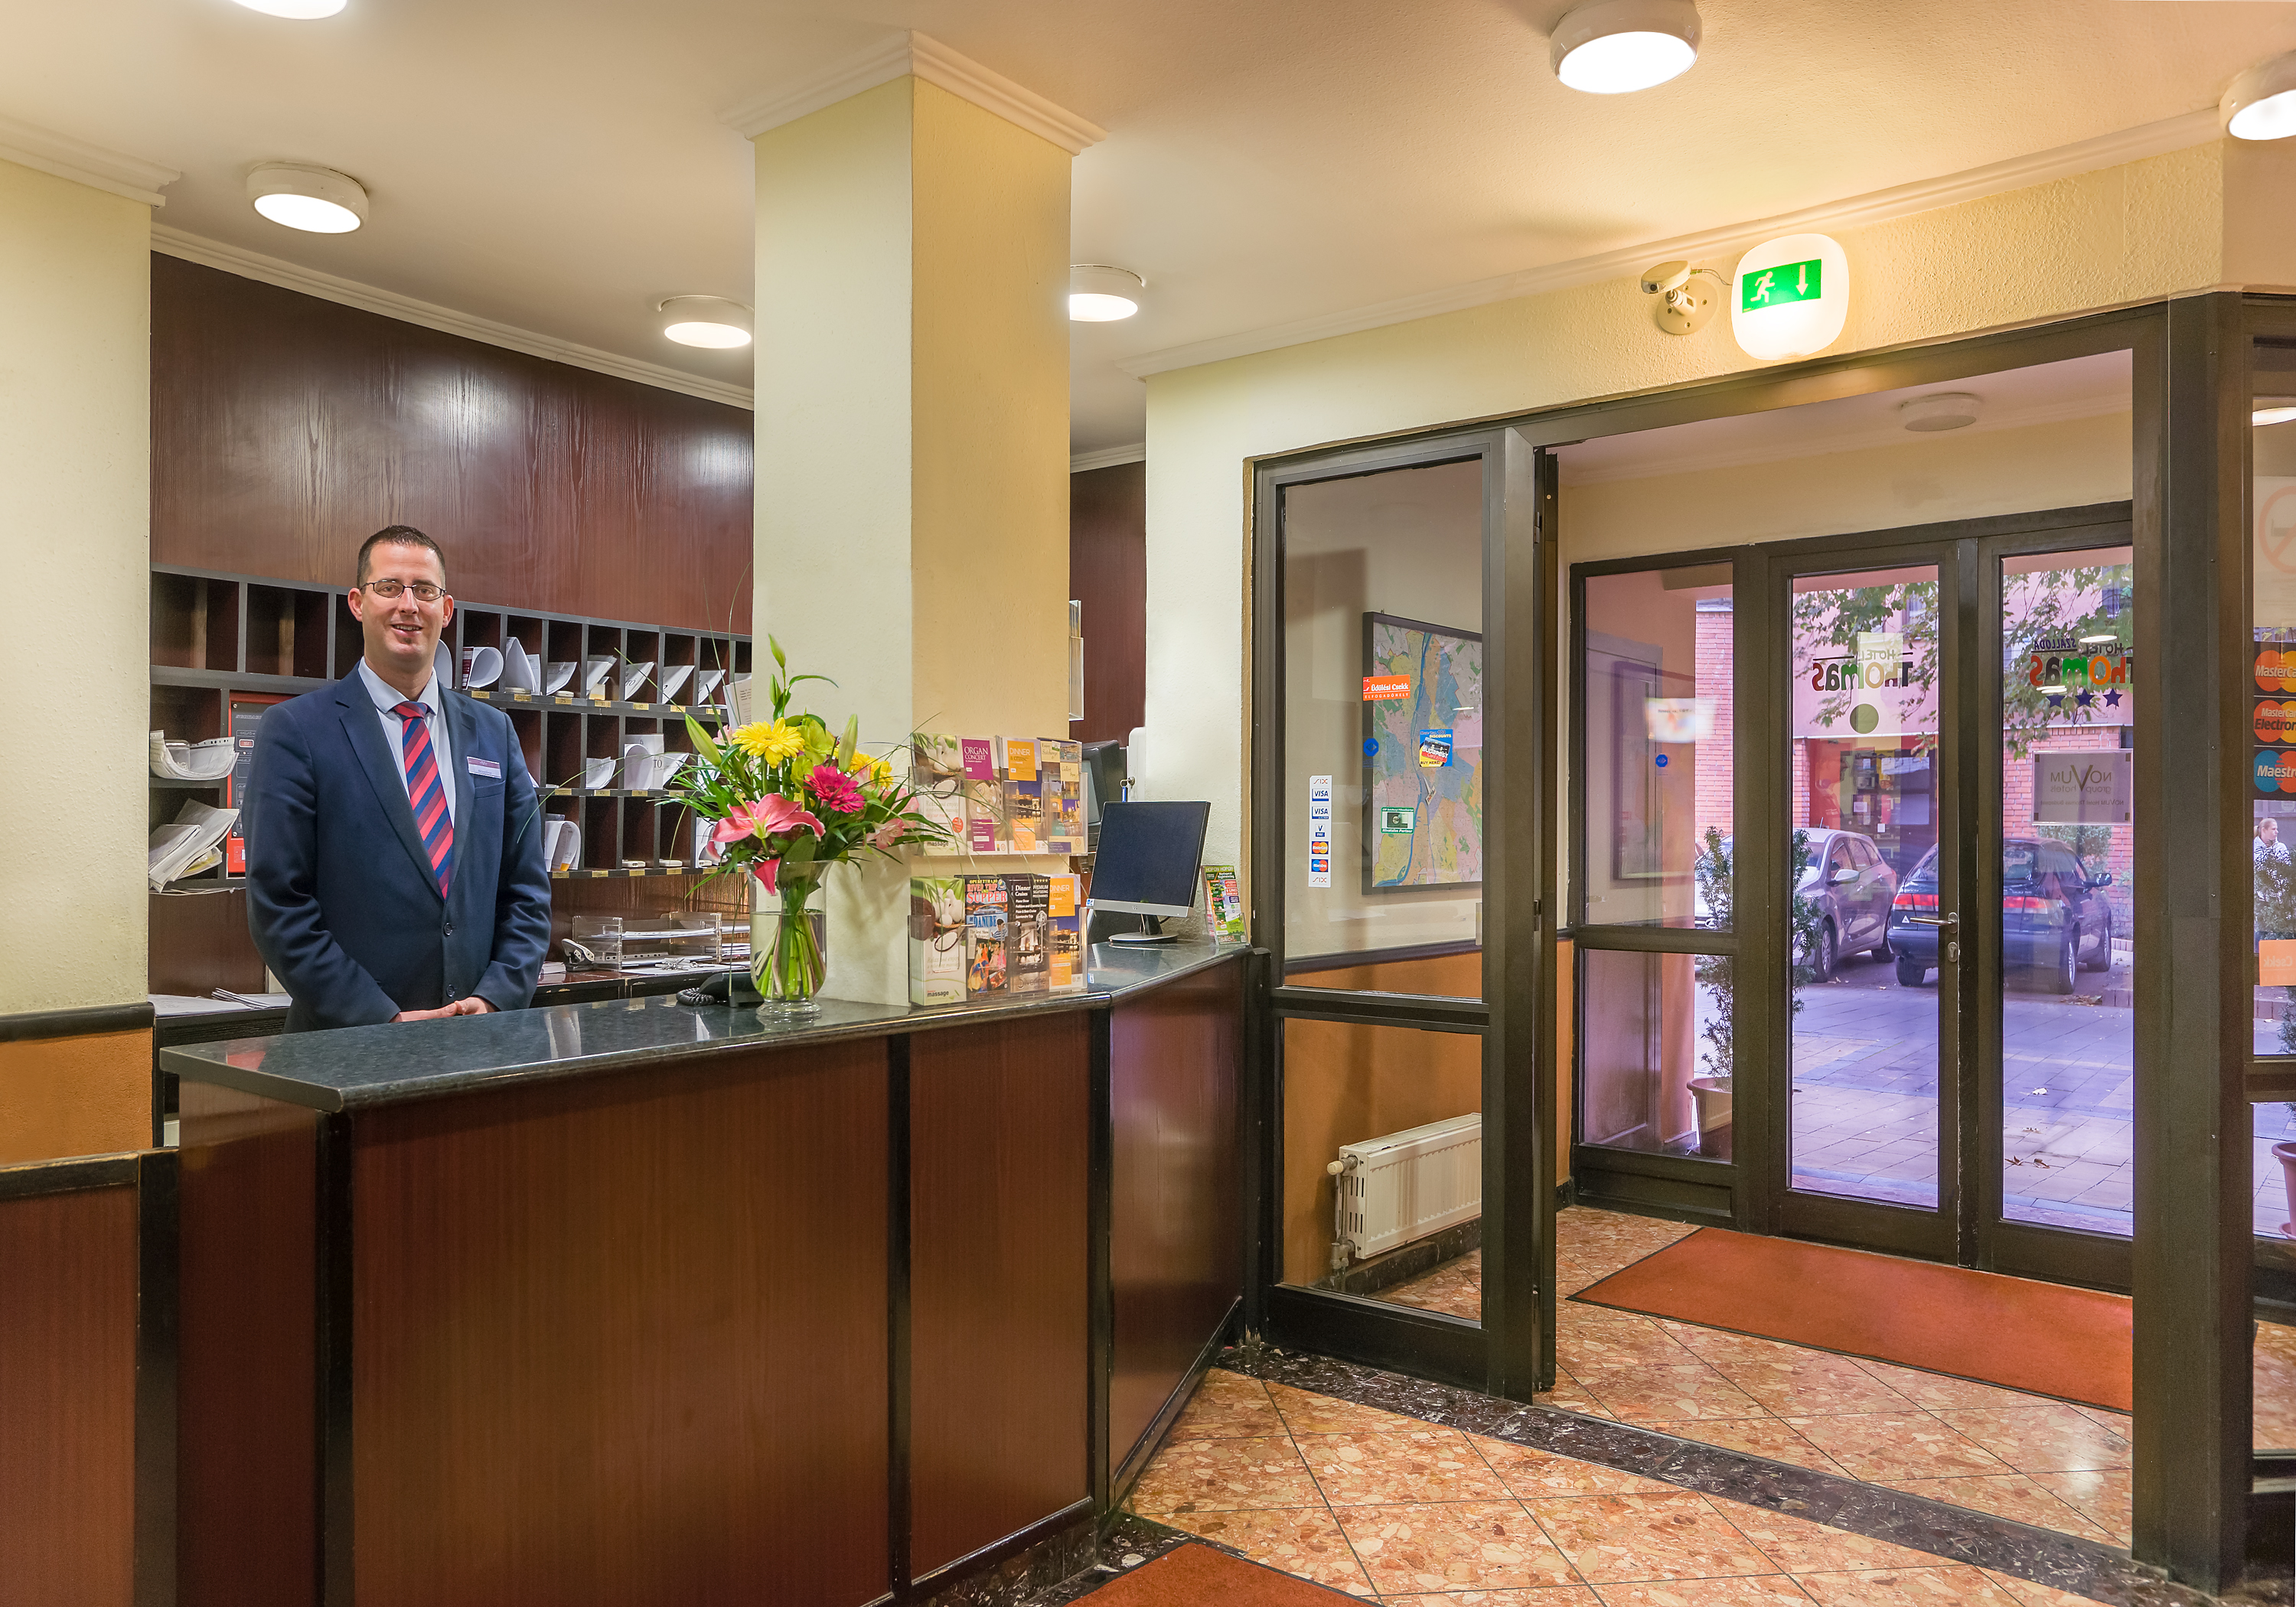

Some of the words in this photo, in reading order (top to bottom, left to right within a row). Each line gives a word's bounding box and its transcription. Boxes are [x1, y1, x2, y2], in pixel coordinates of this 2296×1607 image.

[964, 746, 989, 755] ORGAN
[1009, 748, 1030, 756] DINNER
[967, 891, 1007, 904] SUPPER
[974, 916, 996, 927] DANUBE
